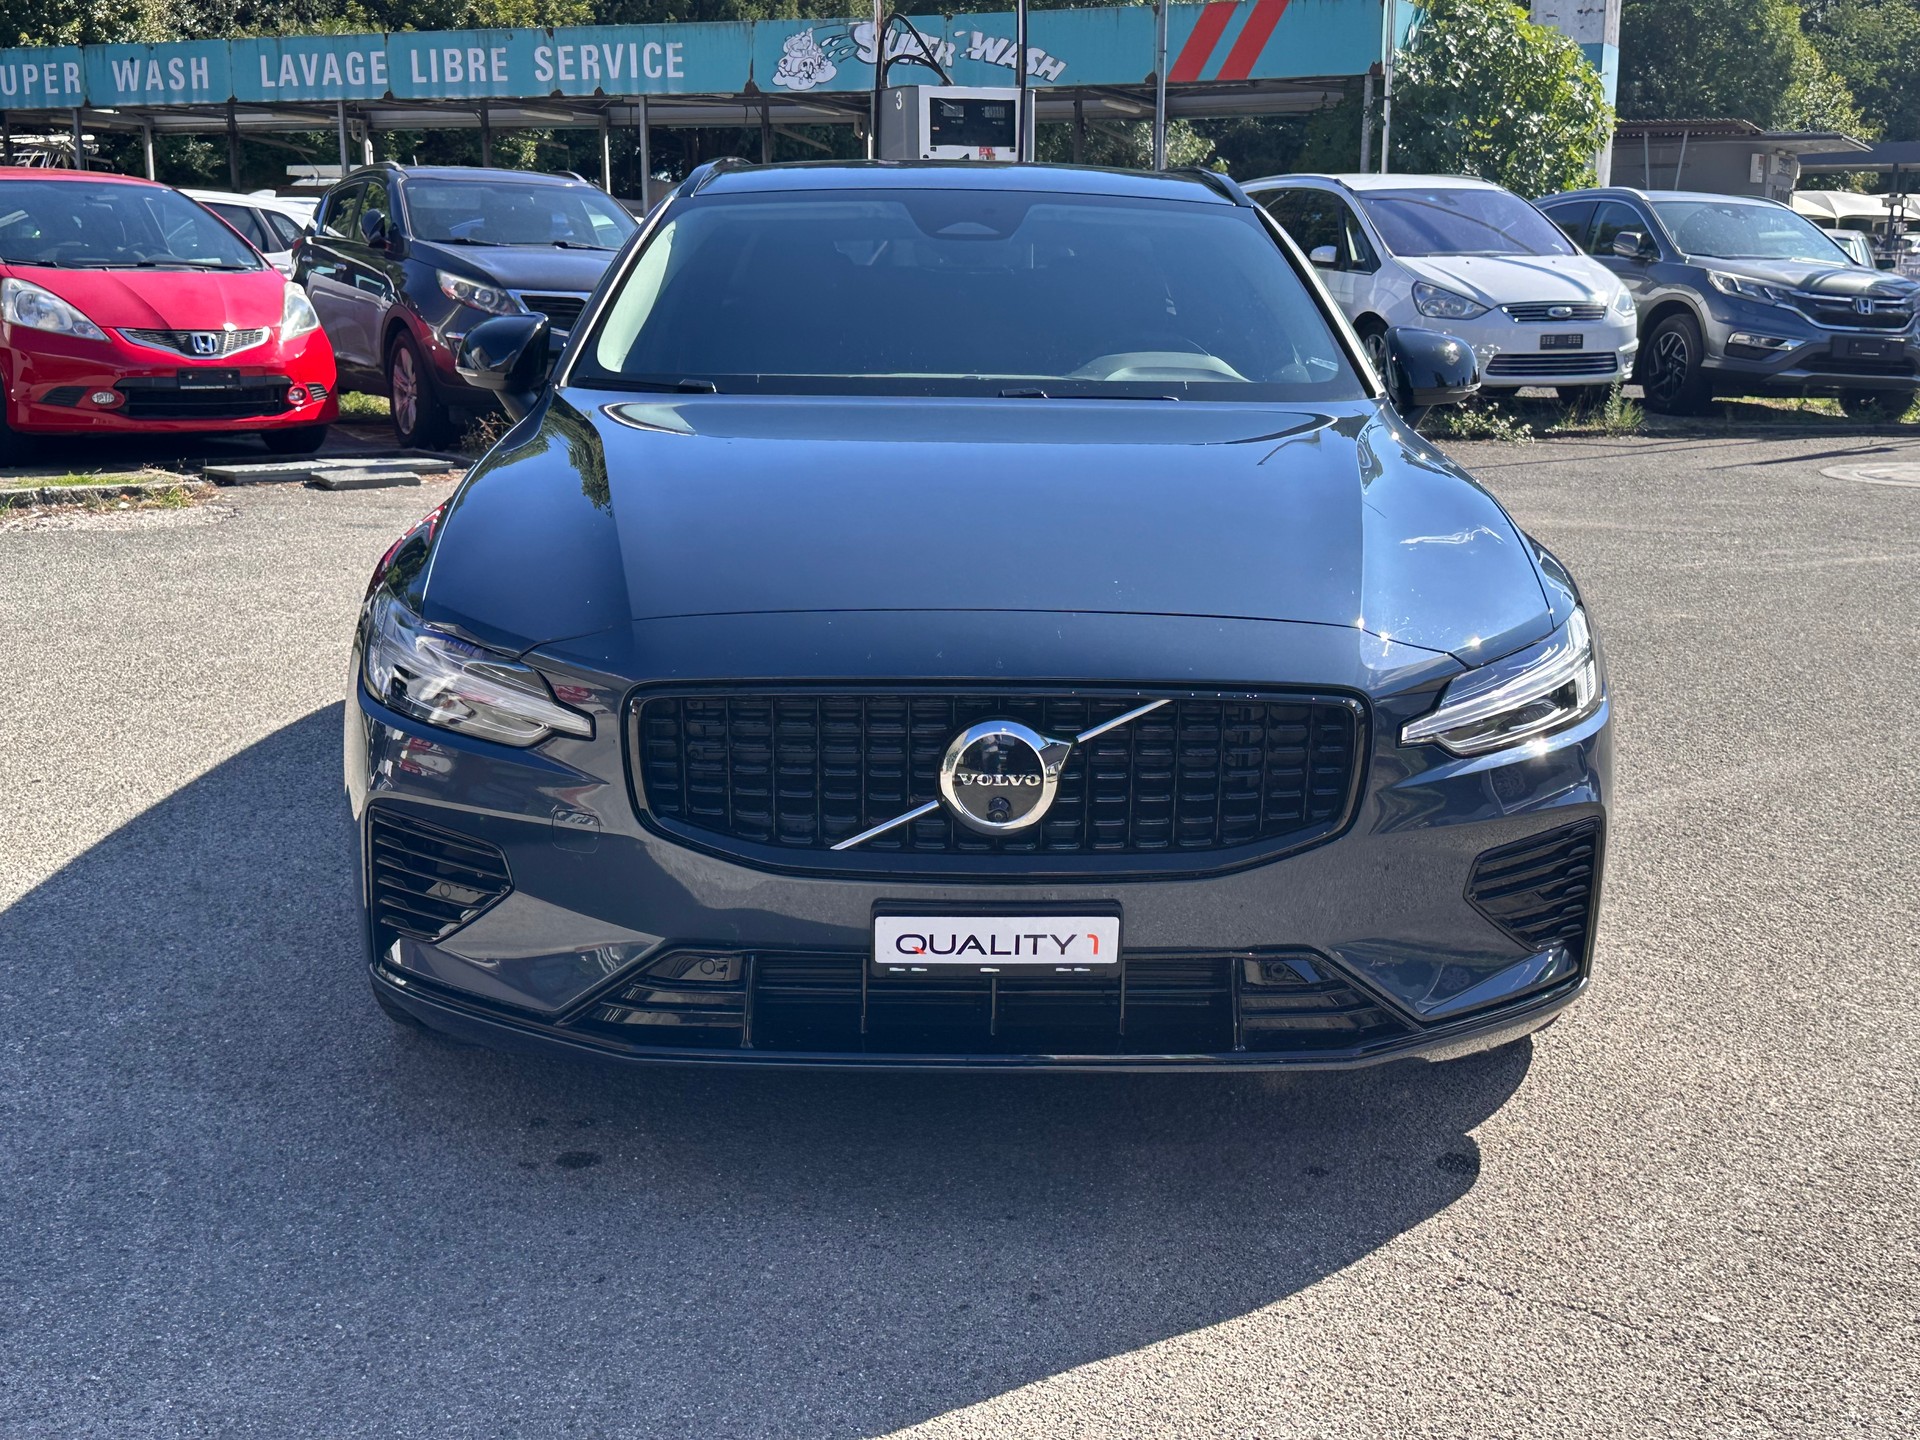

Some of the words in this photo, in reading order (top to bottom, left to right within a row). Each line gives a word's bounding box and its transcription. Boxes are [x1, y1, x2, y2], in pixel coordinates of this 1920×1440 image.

[851, 21, 956, 67] SUPER
[969, 30, 1067, 82] WASH
[0, 62, 82, 96] UPER
[111, 57, 209, 92] WASH
[260, 51, 388, 88] LAVAGE
[410, 47, 509, 84] LIBRE
[533, 42, 685, 81] SERVICE
[895, 90, 903, 110] 3
[957, 773, 1041, 787] VOLVO
[895, 933, 1078, 956] QUALITY
[1086, 933, 1099, 955] 1
